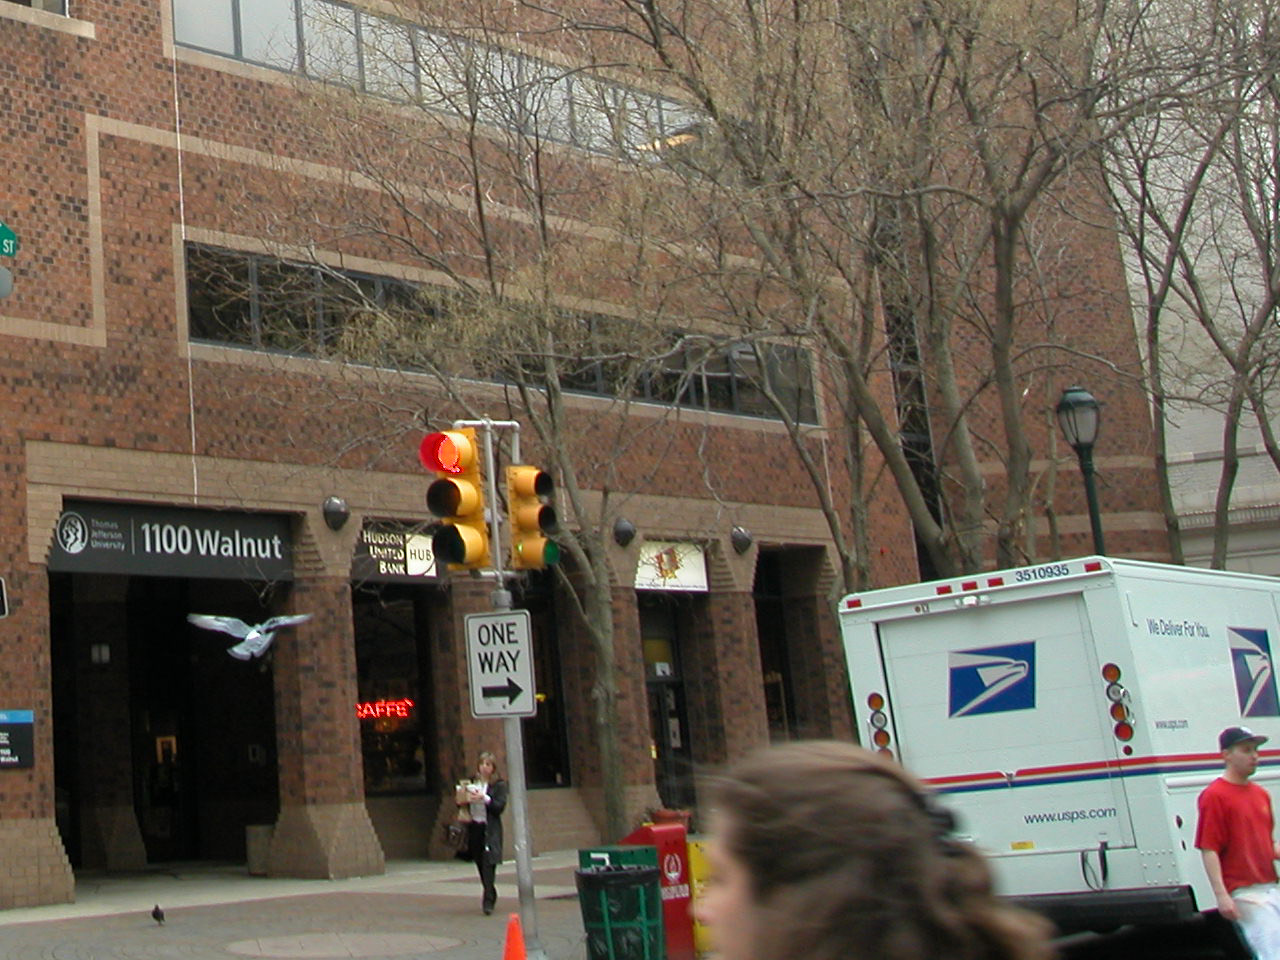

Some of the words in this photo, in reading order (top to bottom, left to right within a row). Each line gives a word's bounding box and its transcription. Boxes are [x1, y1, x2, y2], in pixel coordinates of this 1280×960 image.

[3, 239, 15, 253] ST
[91, 518, 118, 529] Thomas
[91, 529, 123, 540] Jefferson
[141, 522, 192, 555] 1100
[195, 529, 283, 559] Walnut
[363, 530, 404, 546] HUDSON
[91, 539, 125, 552] University
[410, 548, 432, 561] HUB
[1015, 564, 1070, 582] 3510935
[478, 622, 519, 647] ONE
[1146, 618, 1159, 635] We
[1159, 619, 1183, 636] Deliver
[1184, 621, 1195, 637] For
[478, 649, 521, 674] WAY
[1024, 807, 1117, 824] www.usps.com
